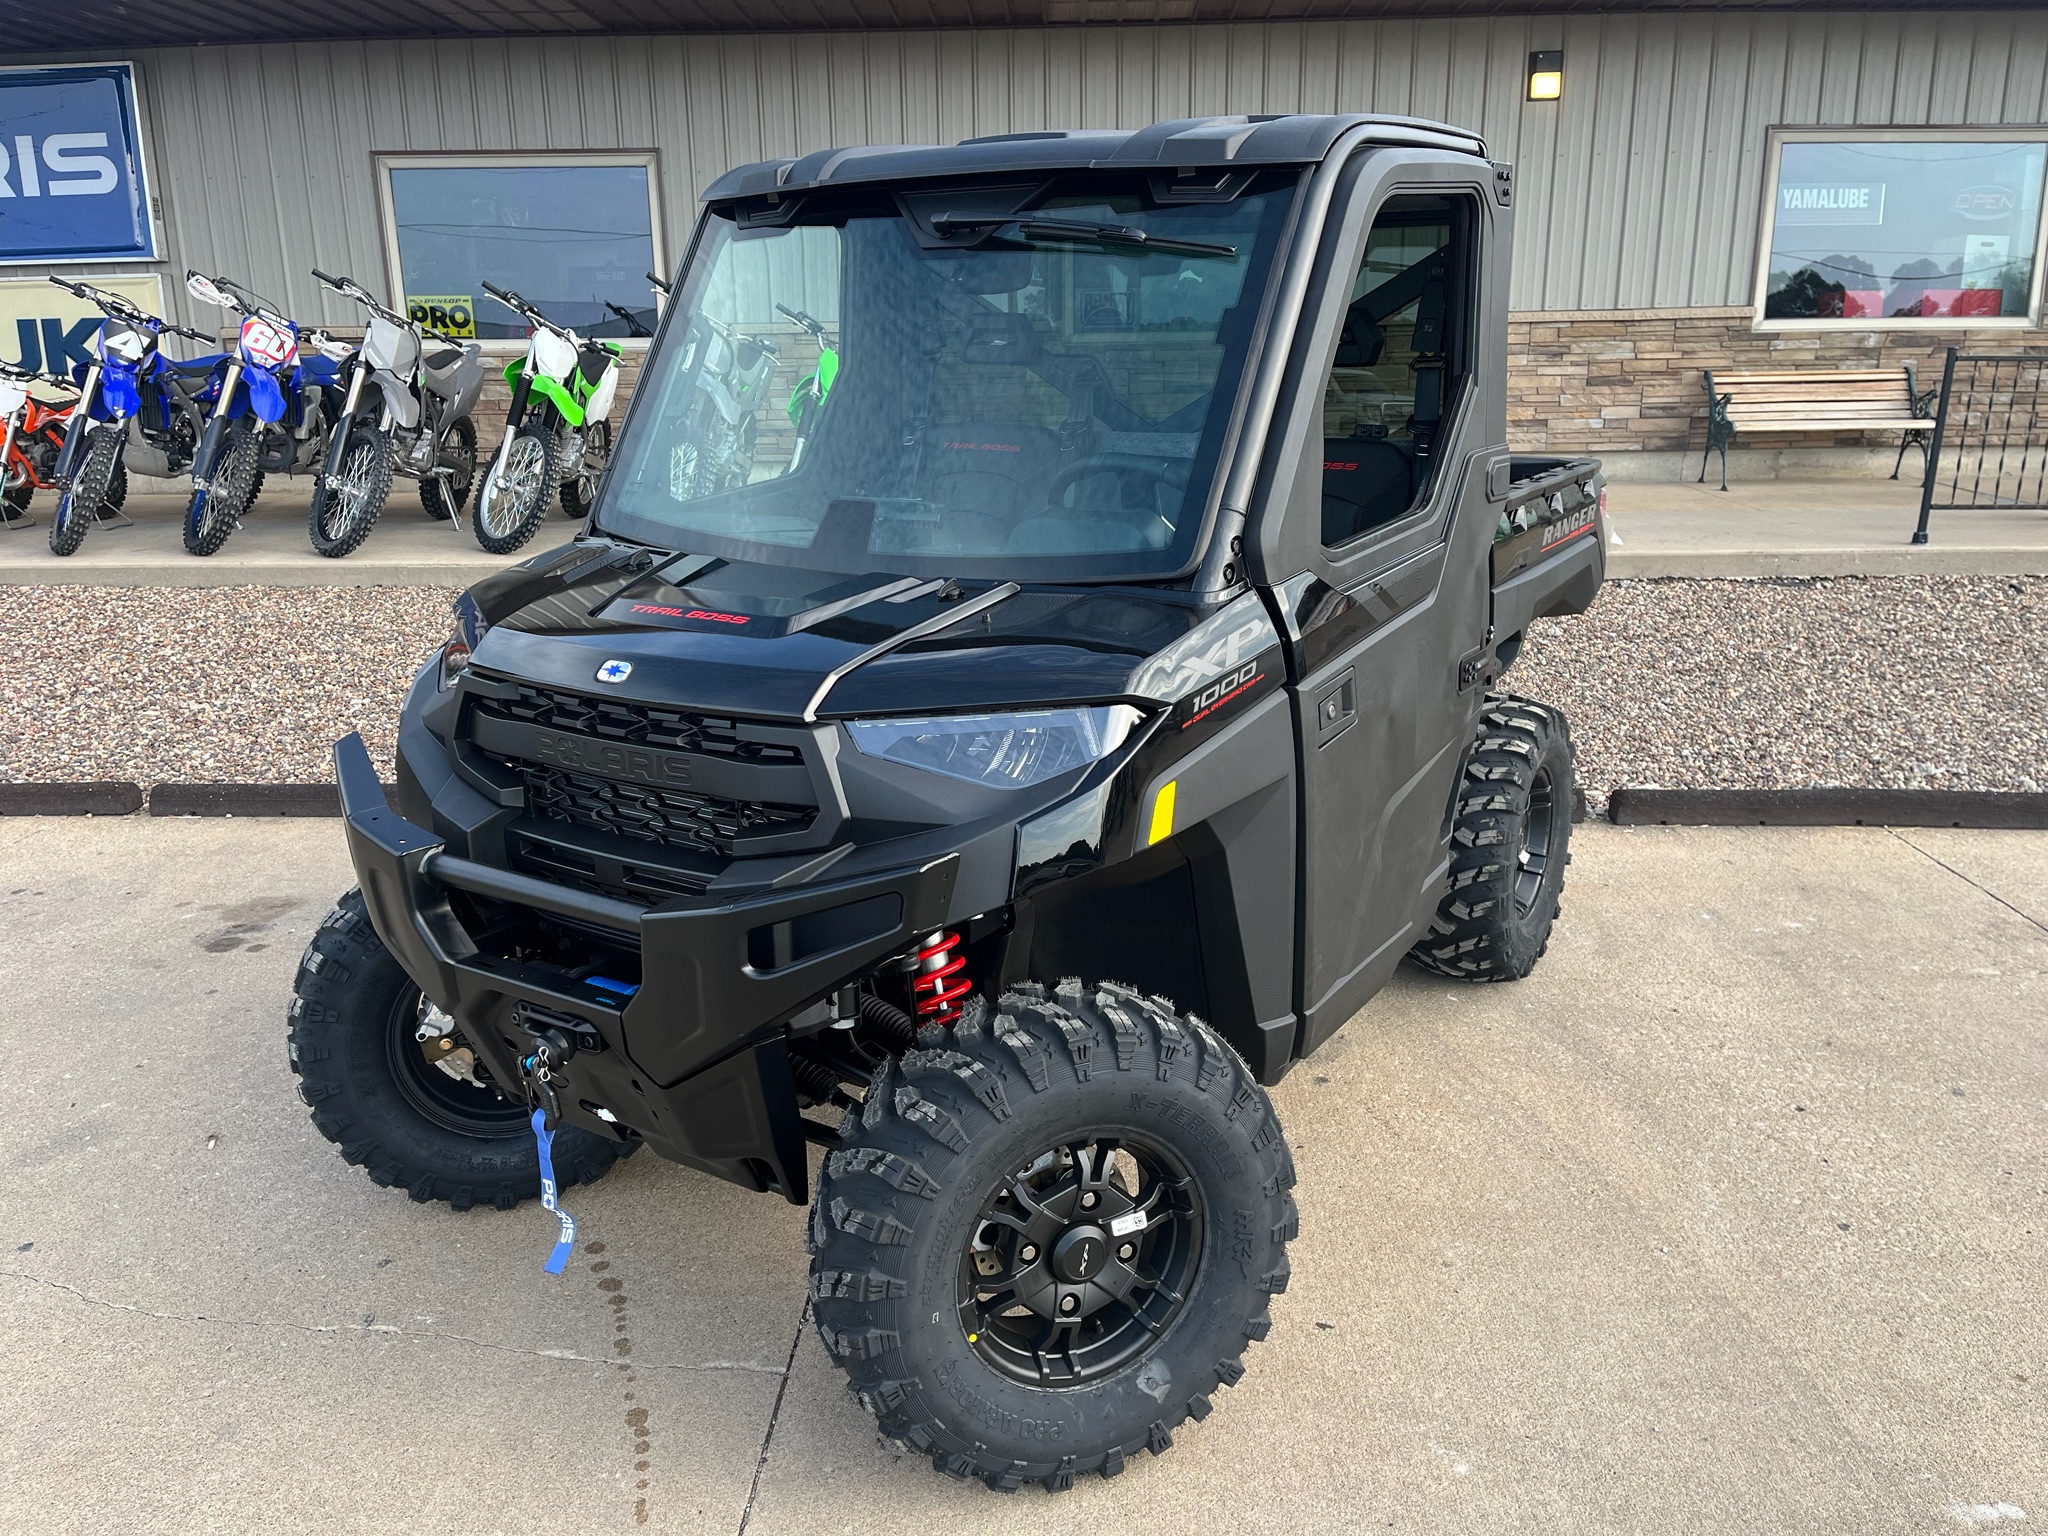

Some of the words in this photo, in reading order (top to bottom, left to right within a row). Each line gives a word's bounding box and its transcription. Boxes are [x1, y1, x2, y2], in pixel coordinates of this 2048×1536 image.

[1783, 188, 1869, 209] YAMALUBE
[1955, 194, 2016, 209] OPEN
[410, 305, 471, 329] PRO
[103, 330, 151, 360] 4
[243, 322, 295, 361] 60
[981, 443, 1021, 452] BOSS
[1542, 504, 1597, 546] RANGER
[630, 604, 683, 617] TRAIL
[685, 610, 750, 624] BOSS
[1179, 619, 1264, 697] XP
[1192, 660, 1257, 713] 1000
[535, 732, 693, 786] POLARIS
[1124, 1091, 1244, 1182] X-TERRAIN
[948, 1375, 1018, 1434] ARMOR
[1020, 1418, 1065, 1441] PRO
